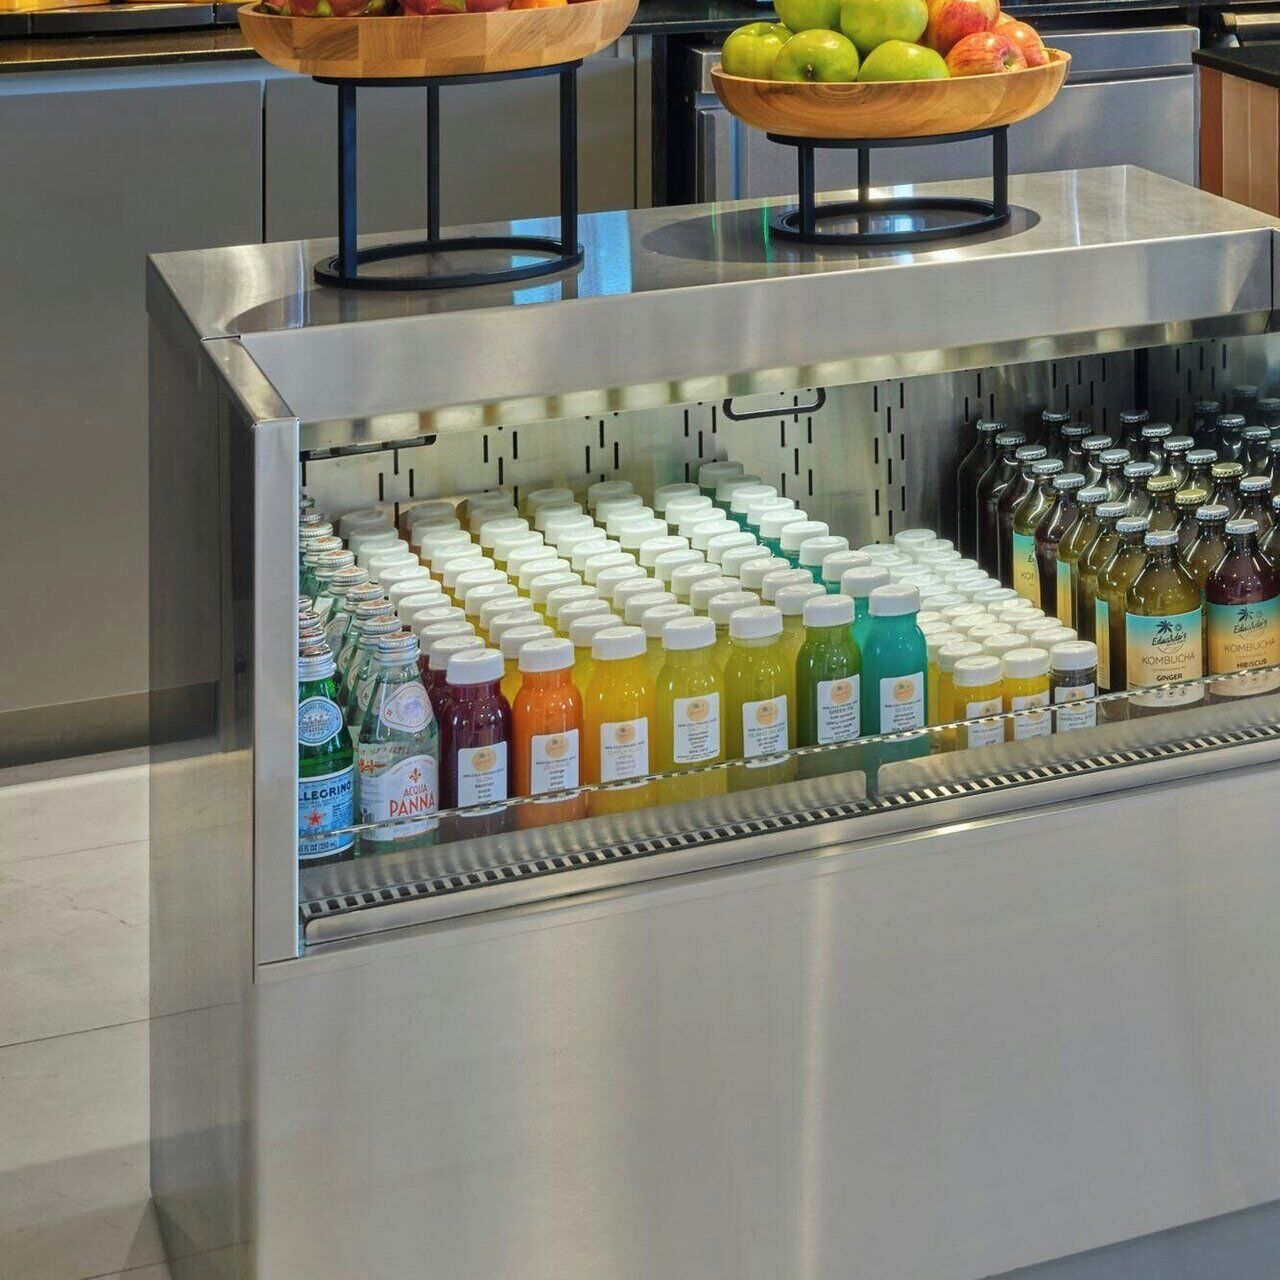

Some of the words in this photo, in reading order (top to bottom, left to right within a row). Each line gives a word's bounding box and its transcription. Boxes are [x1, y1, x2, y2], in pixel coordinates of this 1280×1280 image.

[1224, 638, 1276, 654] KOMBUCHA
[1142, 652, 1194, 666] KOMBUCHA
[1236, 658, 1268, 669] HIBISCUS
[1156, 673, 1183, 682] GINGER
[404, 784, 428, 797] ACQUA
[390, 794, 436, 817] PANNA
